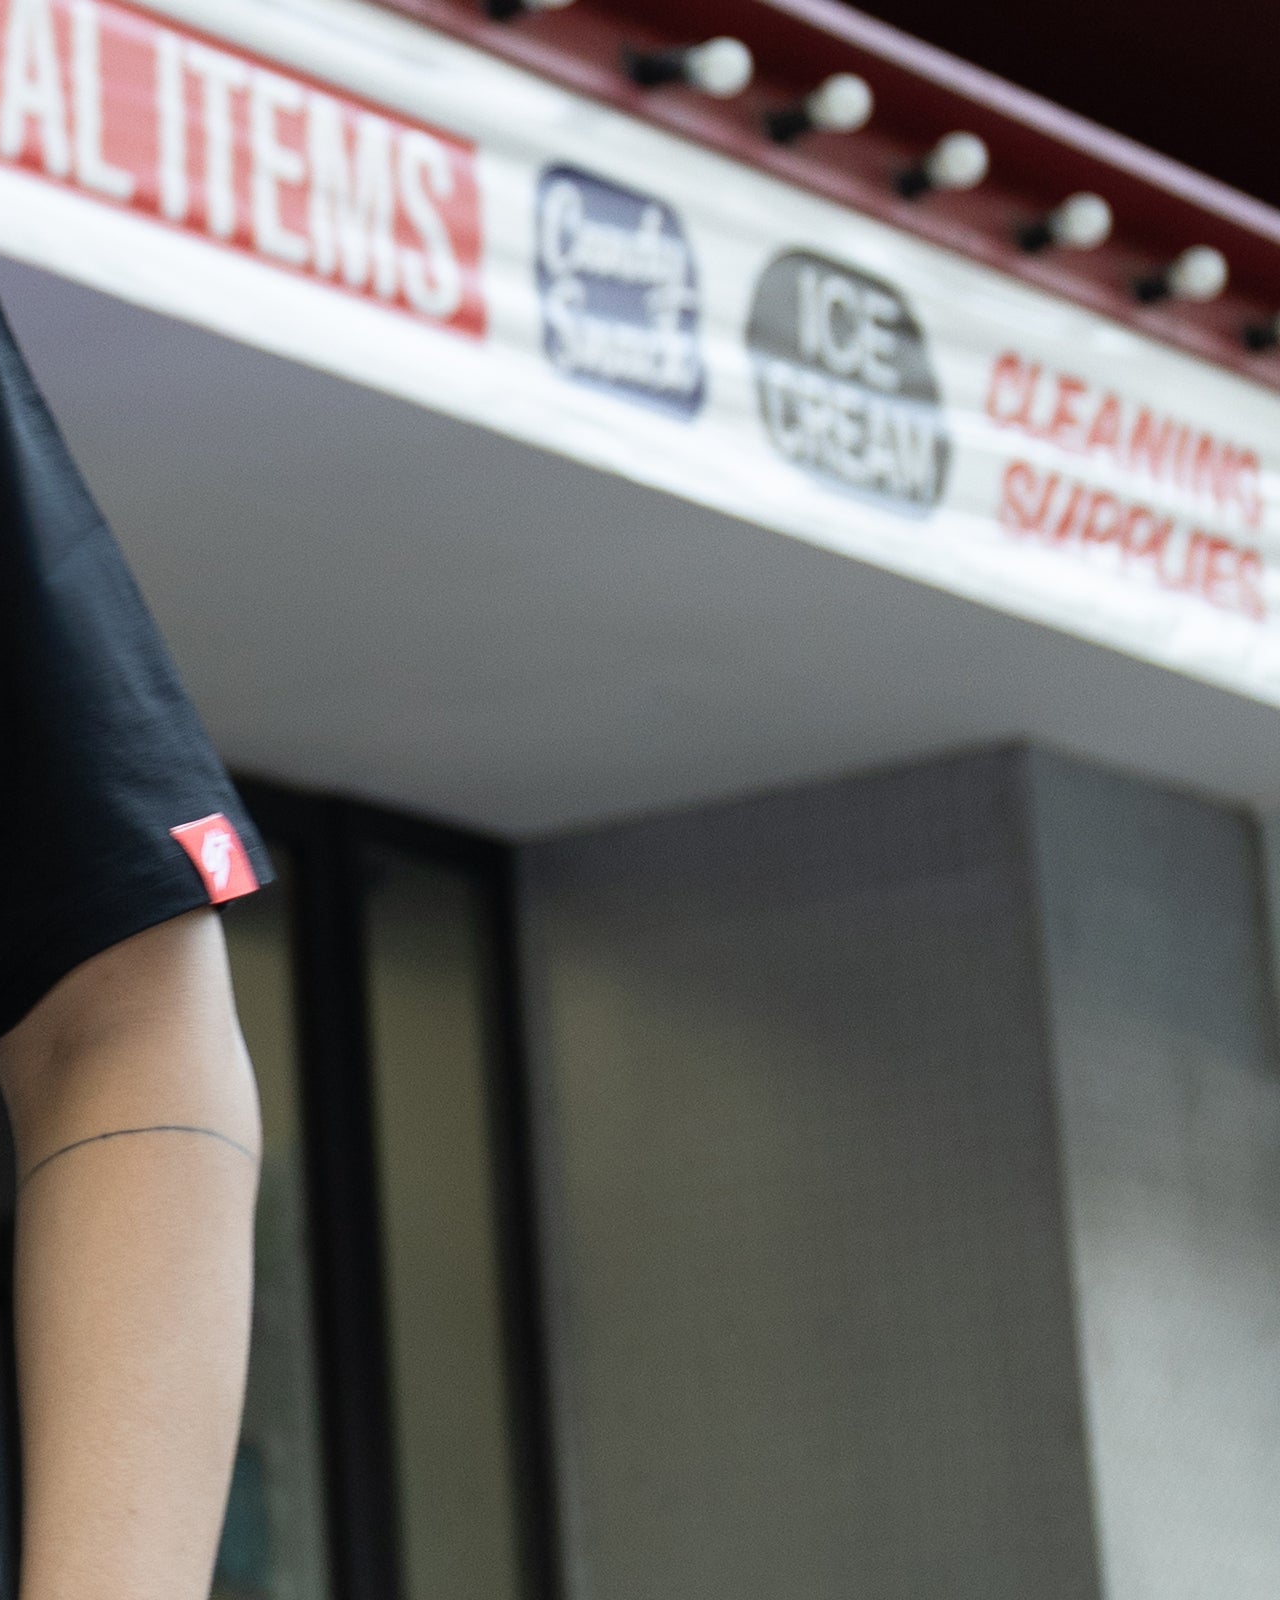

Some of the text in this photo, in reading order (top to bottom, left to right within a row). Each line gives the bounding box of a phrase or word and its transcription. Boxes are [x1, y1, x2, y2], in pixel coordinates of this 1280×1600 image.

[153, 30, 464, 322] ITEMS
[797, 266, 901, 391] ICE
[766, 363, 938, 500] CREAM
[984, 350, 1262, 526] CLEANING
[998, 460, 1264, 622] SUPPLIES
